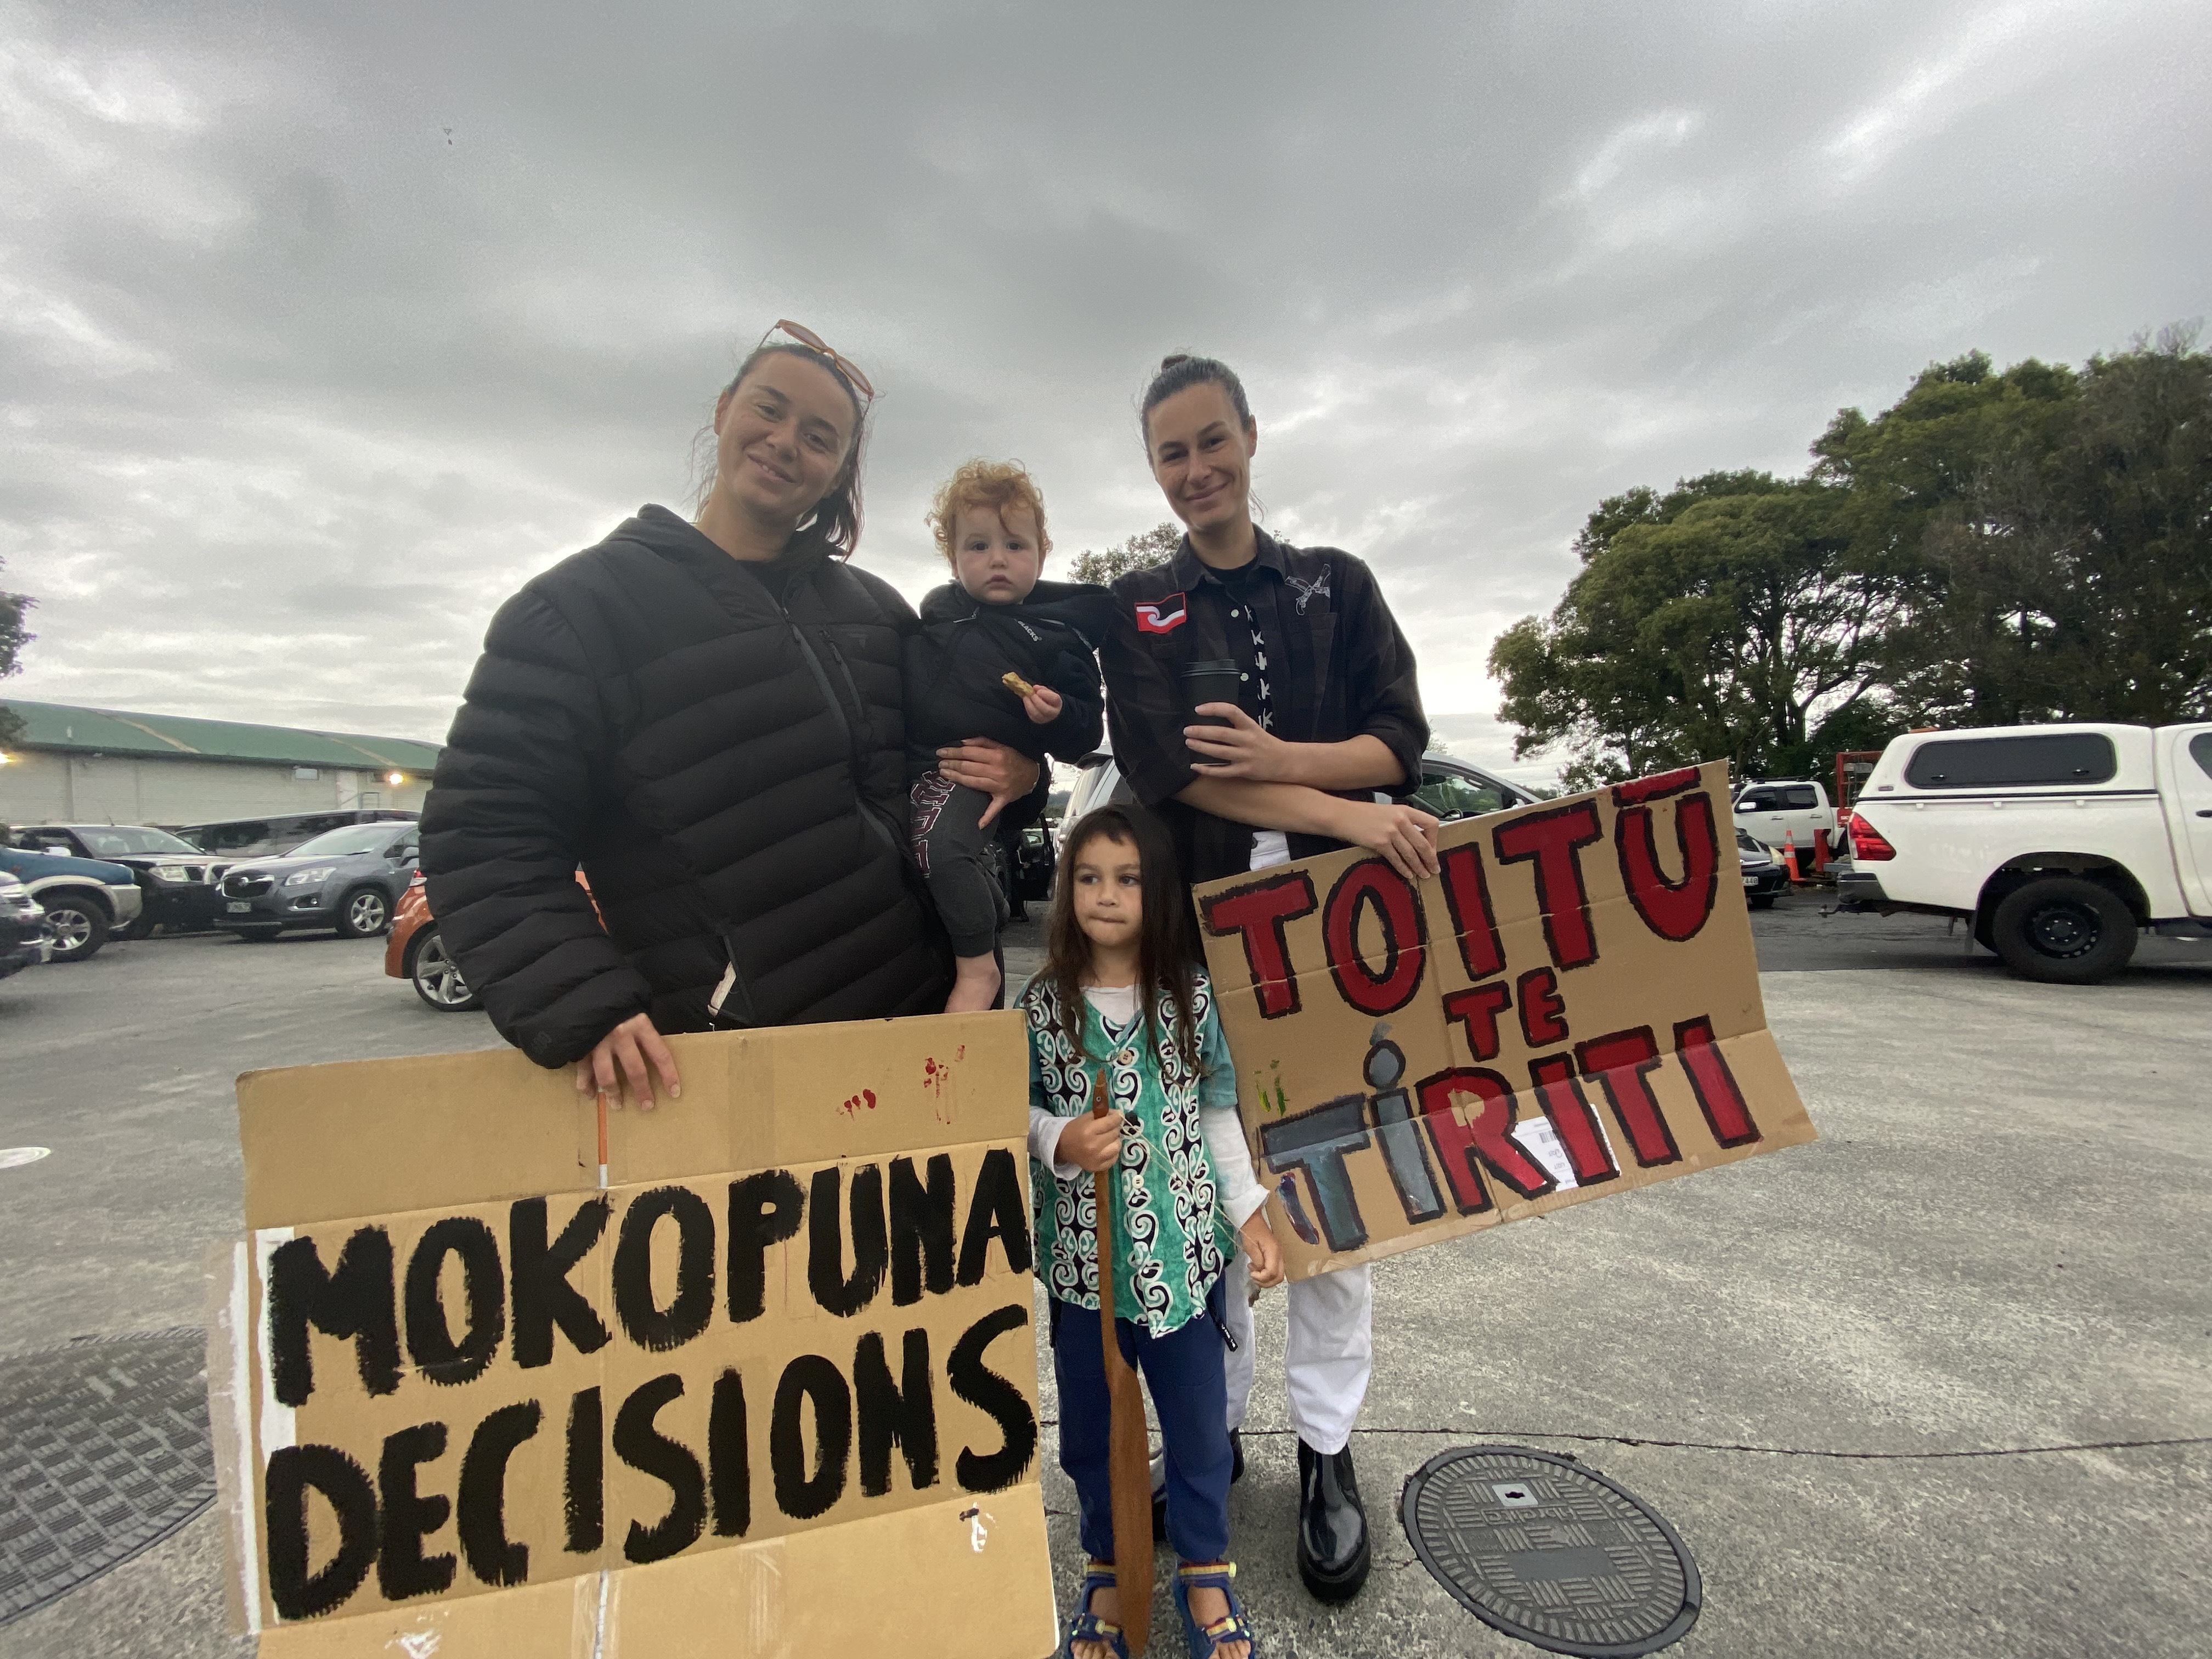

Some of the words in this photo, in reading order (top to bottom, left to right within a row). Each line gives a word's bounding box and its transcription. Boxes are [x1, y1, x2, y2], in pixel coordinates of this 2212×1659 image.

[1018, 620, 1039, 642] BLACKS
[1442, 966, 1570, 1062] TE
[268, 1148, 1032, 1407] MOKOPUNA
[266, 1304, 1037, 1621] DECISIONS
